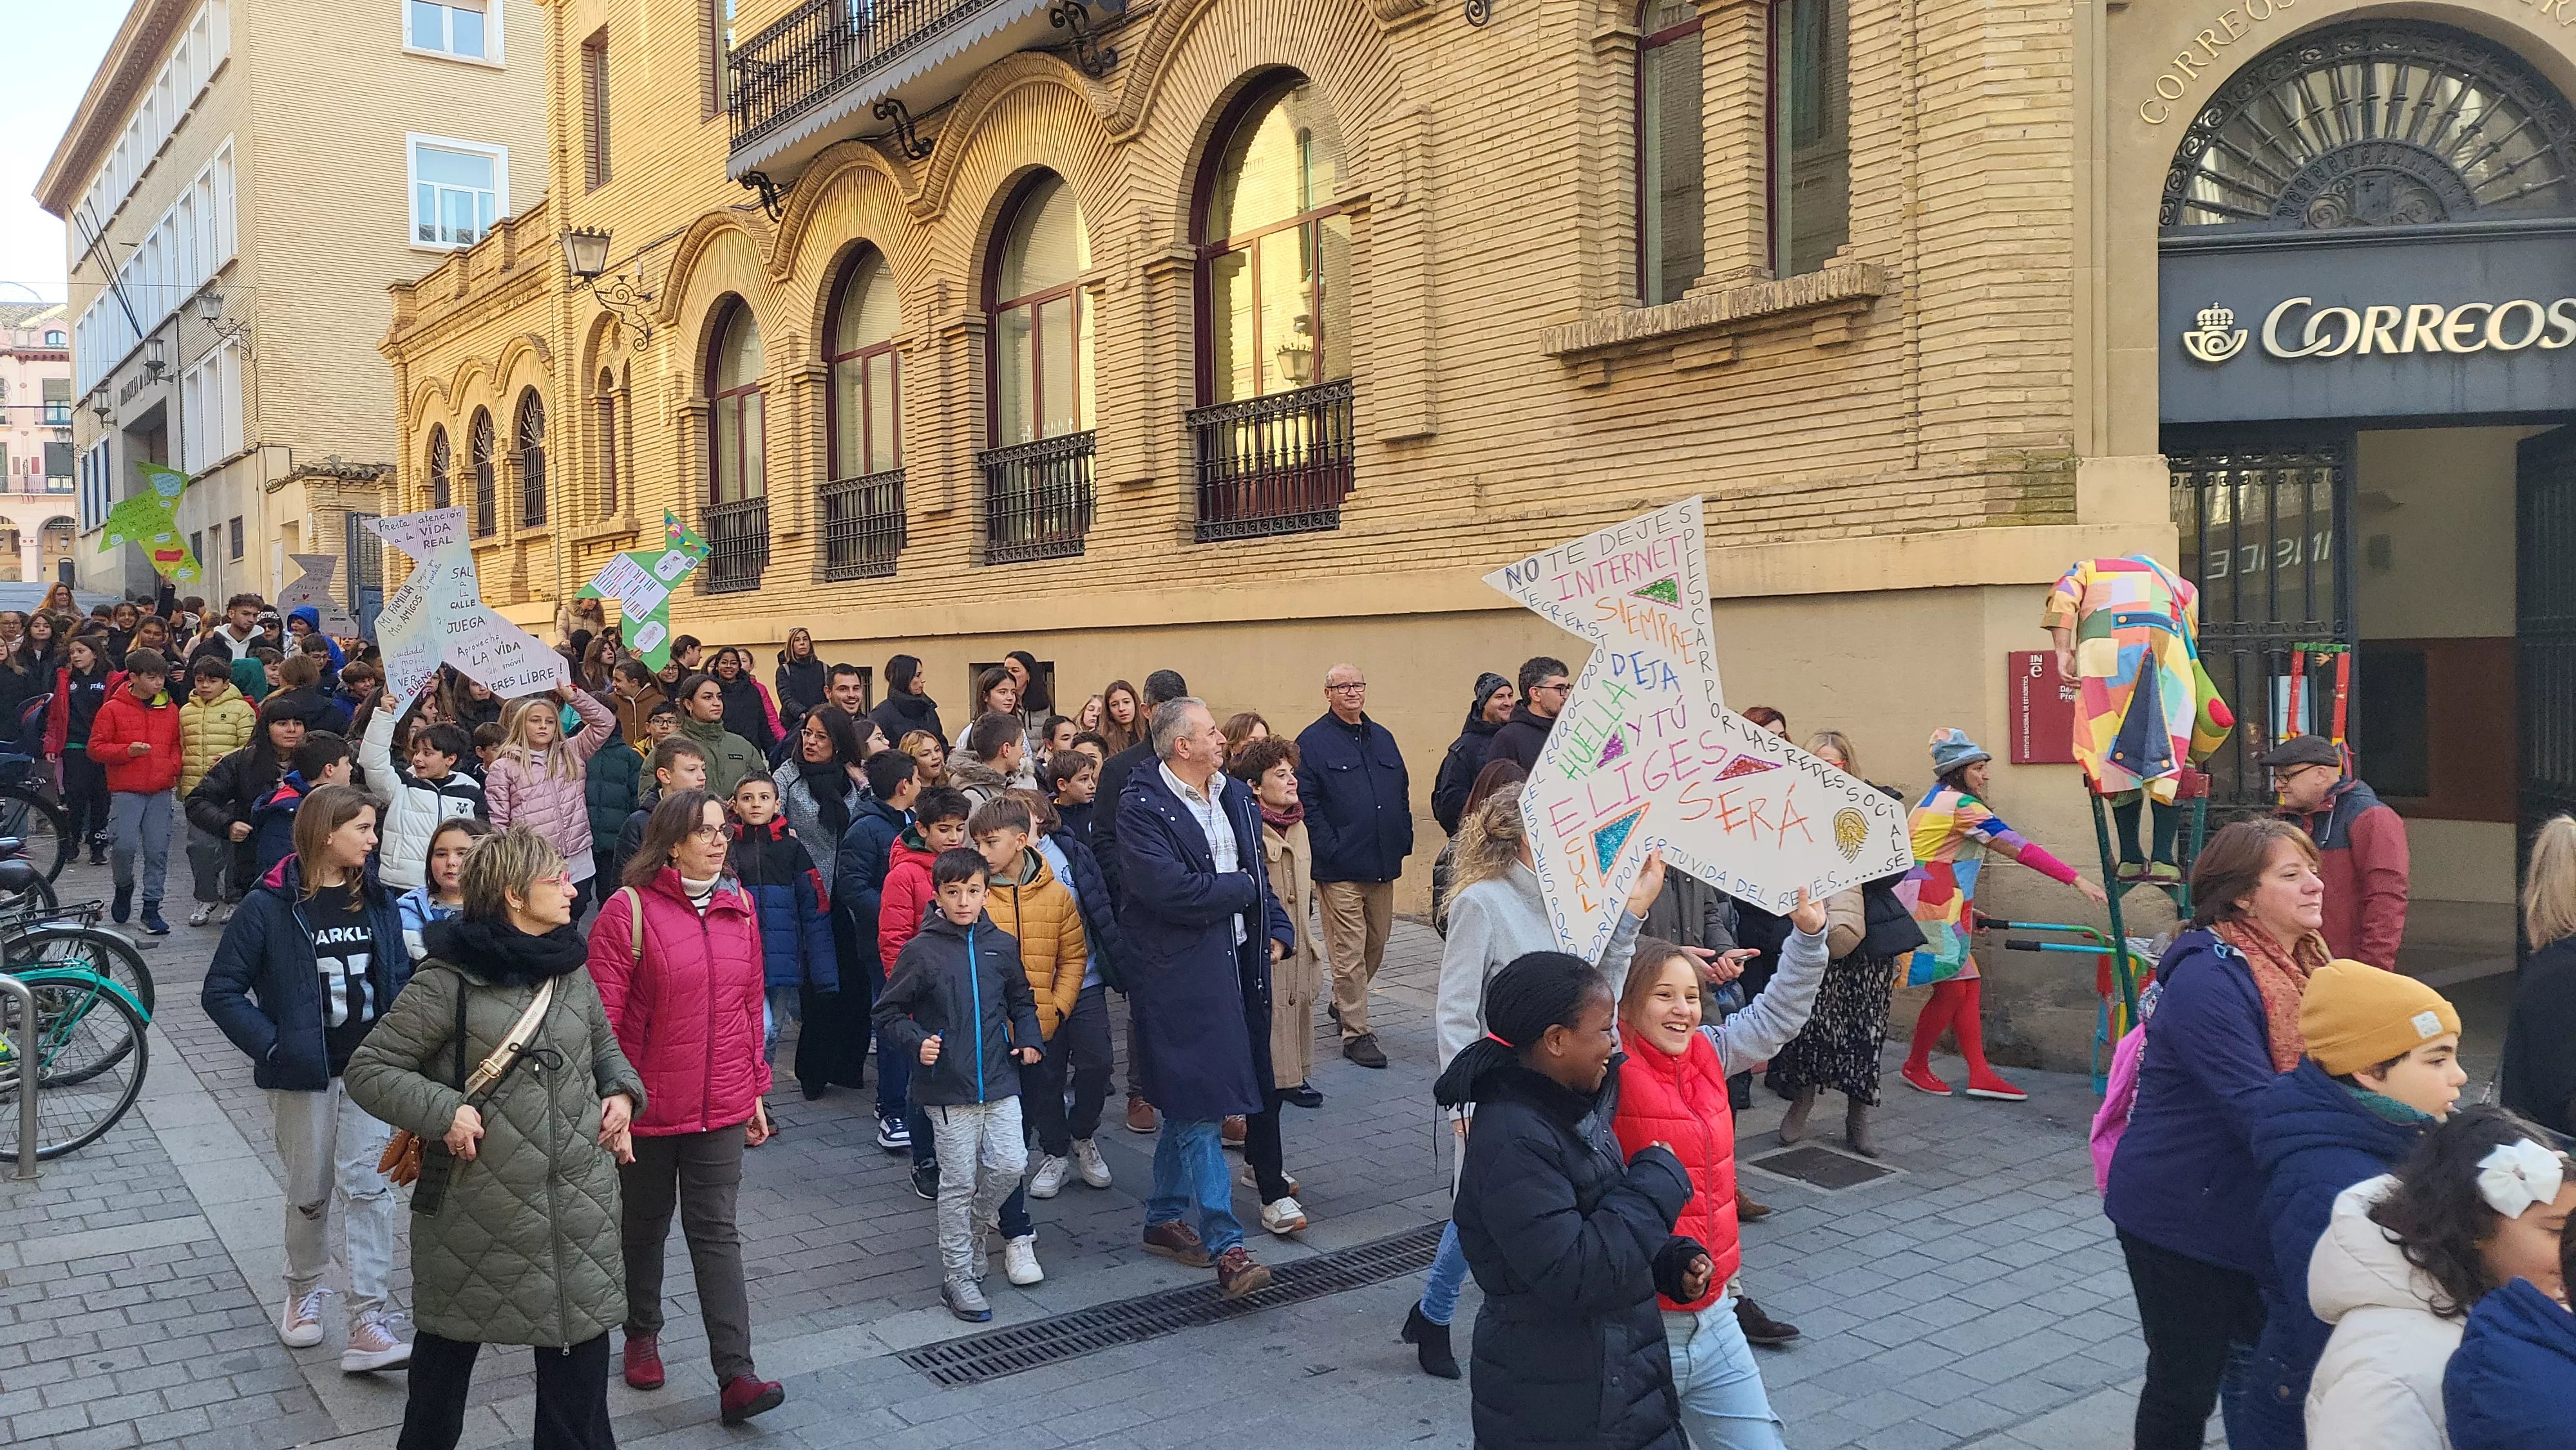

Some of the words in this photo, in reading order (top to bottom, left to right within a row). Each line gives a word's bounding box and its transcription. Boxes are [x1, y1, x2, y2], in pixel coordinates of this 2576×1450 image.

[2261, 297, 2576, 358] CORREOS
[378, 519, 410, 532] Presta
[423, 536, 454, 549] REAL
[451, 566, 473, 579] SAL
[1551, 534, 1683, 602] INTERNET
[450, 599, 476, 610] CALLE
[377, 616, 392, 629] Mi
[388, 623, 402, 637] Mis
[446, 615, 486, 634] JUEGA
[1594, 596, 1696, 665] SIEMPRE
[472, 651, 489, 666] LA
[1505, 558, 1540, 591] NO
[1544, 541, 1587, 572] TE
[1600, 505, 1692, 556] DEJES
[1682, 528, 1714, 673] PESCAR
[1741, 722, 1780, 753] LAS
[1783, 748, 1846, 789] REDES
[397, 674, 417, 687] VER
[406, 671, 432, 697] BUENO
[1611, 650, 1681, 692] DEJA
[1558, 679, 1637, 780] HUELLA
[1625, 714, 1643, 746] Y
[1647, 694, 1687, 737] TÚ
[1517, 586, 1541, 607] TE
[1541, 601, 1600, 637] CREAS
[1671, 846, 1689, 865] TU
[1736, 878, 1768, 906] DEL
[1548, 730, 1729, 838] ELIGES
[1678, 782, 1815, 850] SERÁ
[1564, 837, 1599, 913] CUAL
[312, 927, 373, 945] ARKL
